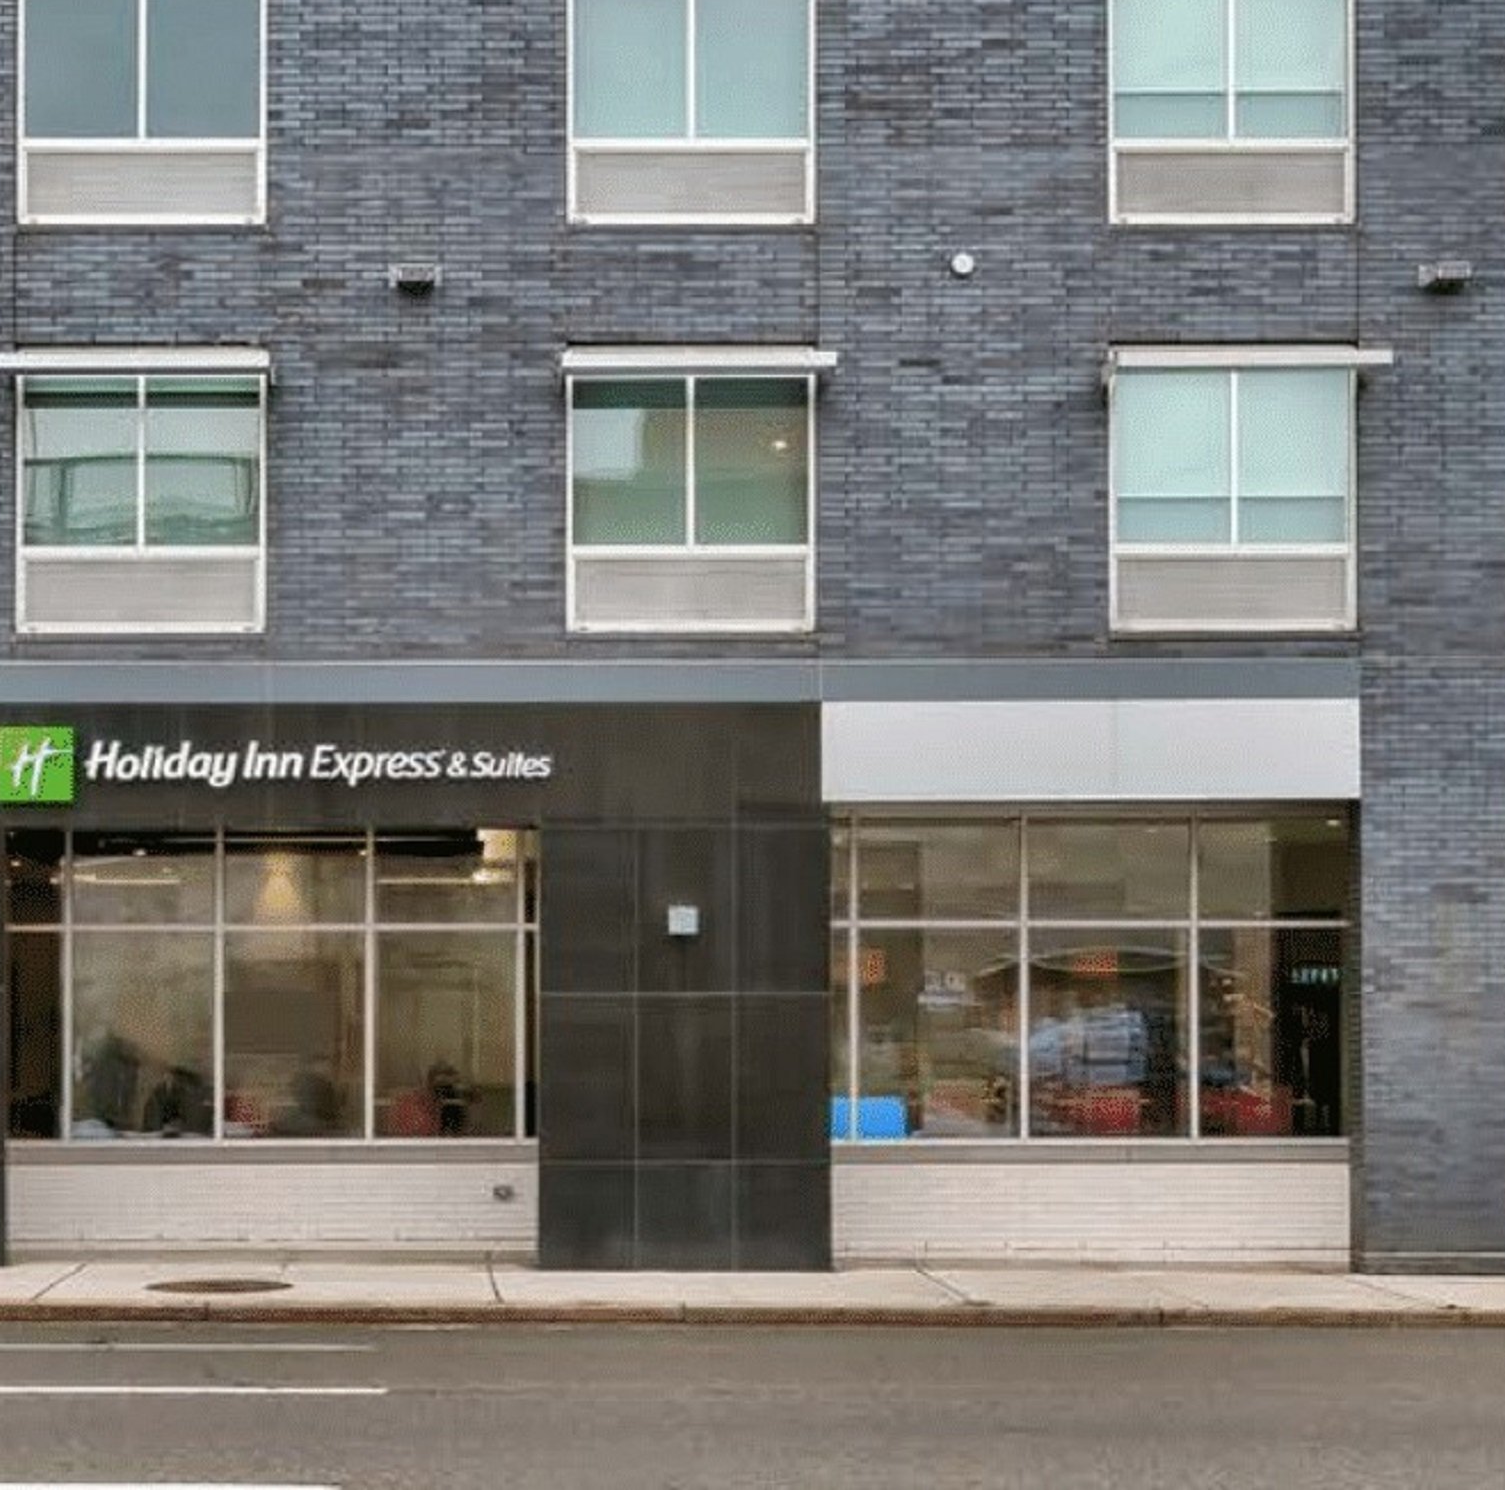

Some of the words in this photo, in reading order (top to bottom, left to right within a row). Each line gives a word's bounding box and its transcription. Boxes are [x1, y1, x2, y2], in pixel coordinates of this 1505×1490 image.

[85, 739, 238, 788] Holiday
[243, 739, 304, 780] Inn
[309, 743, 442, 788] Express
[446, 751, 467, 778] &
[469, 751, 552, 779] Suites
